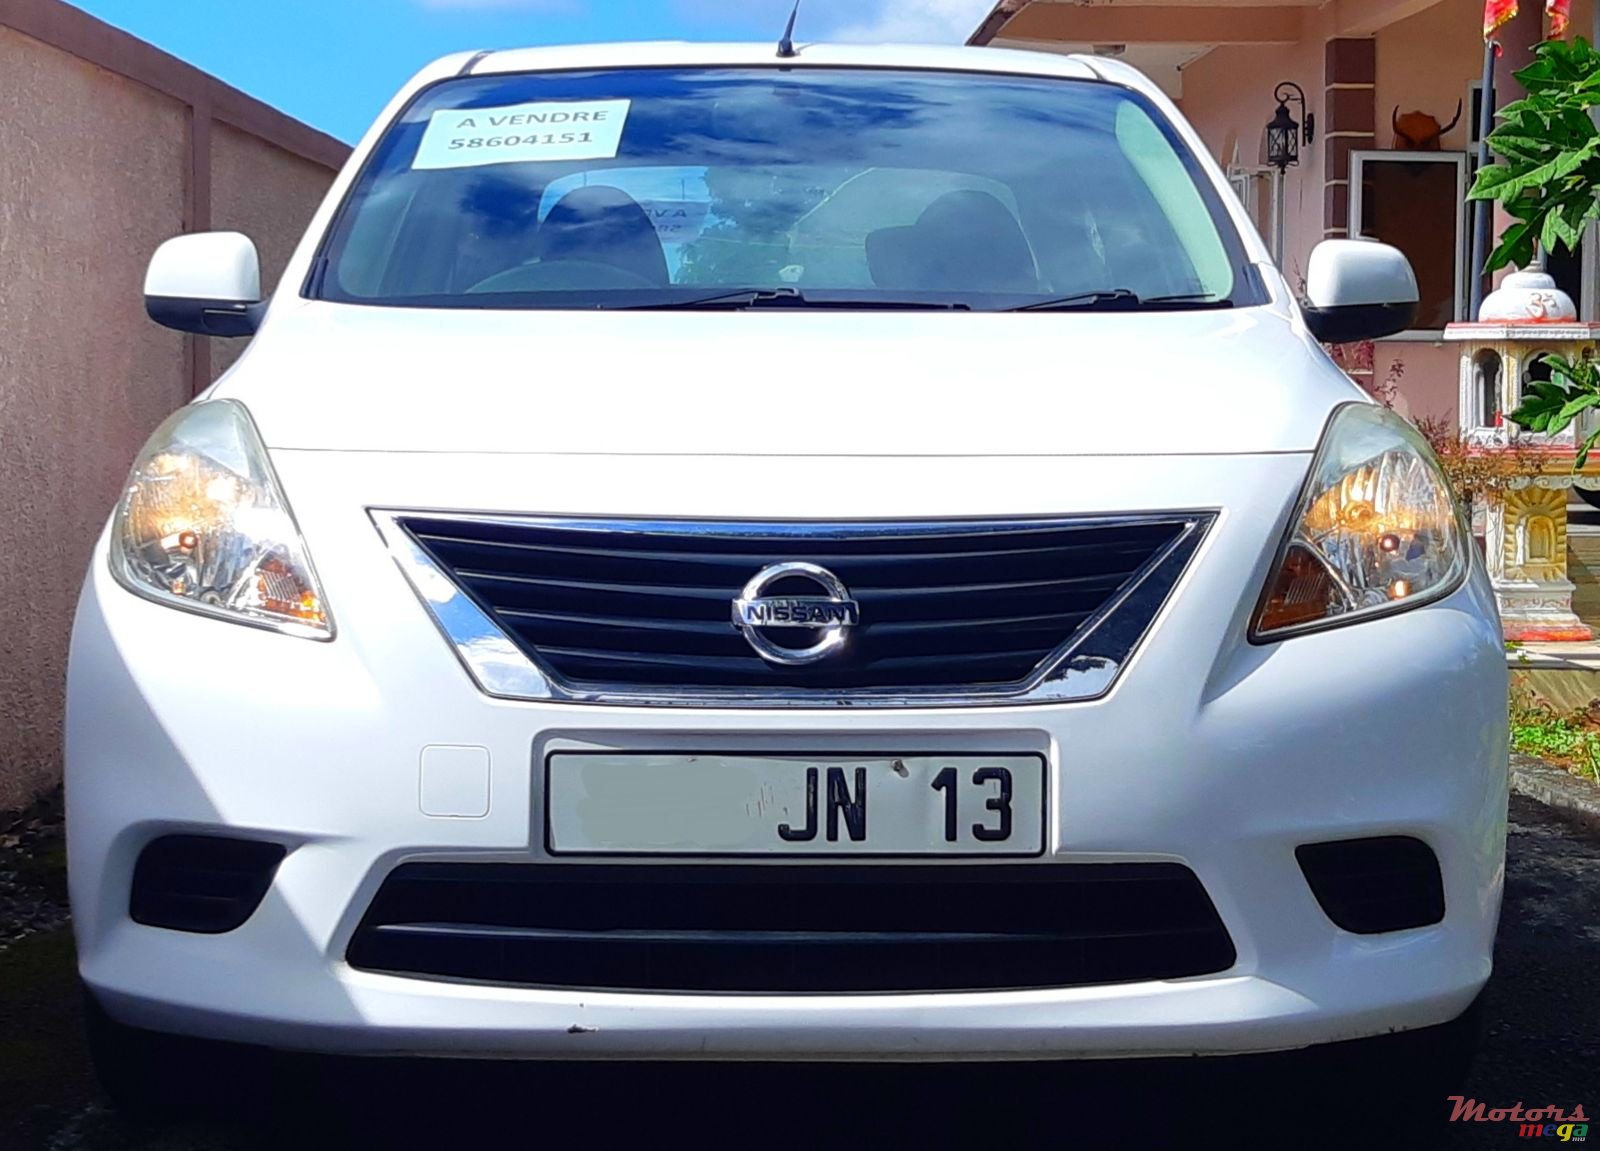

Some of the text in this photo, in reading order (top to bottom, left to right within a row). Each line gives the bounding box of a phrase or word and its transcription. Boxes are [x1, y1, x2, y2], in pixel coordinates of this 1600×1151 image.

[457, 110, 609, 128] A VENDRE
[448, 132, 593, 150] 58604151
[746, 601, 859, 625] NISSAN
[778, 767, 1013, 842] JN 13
